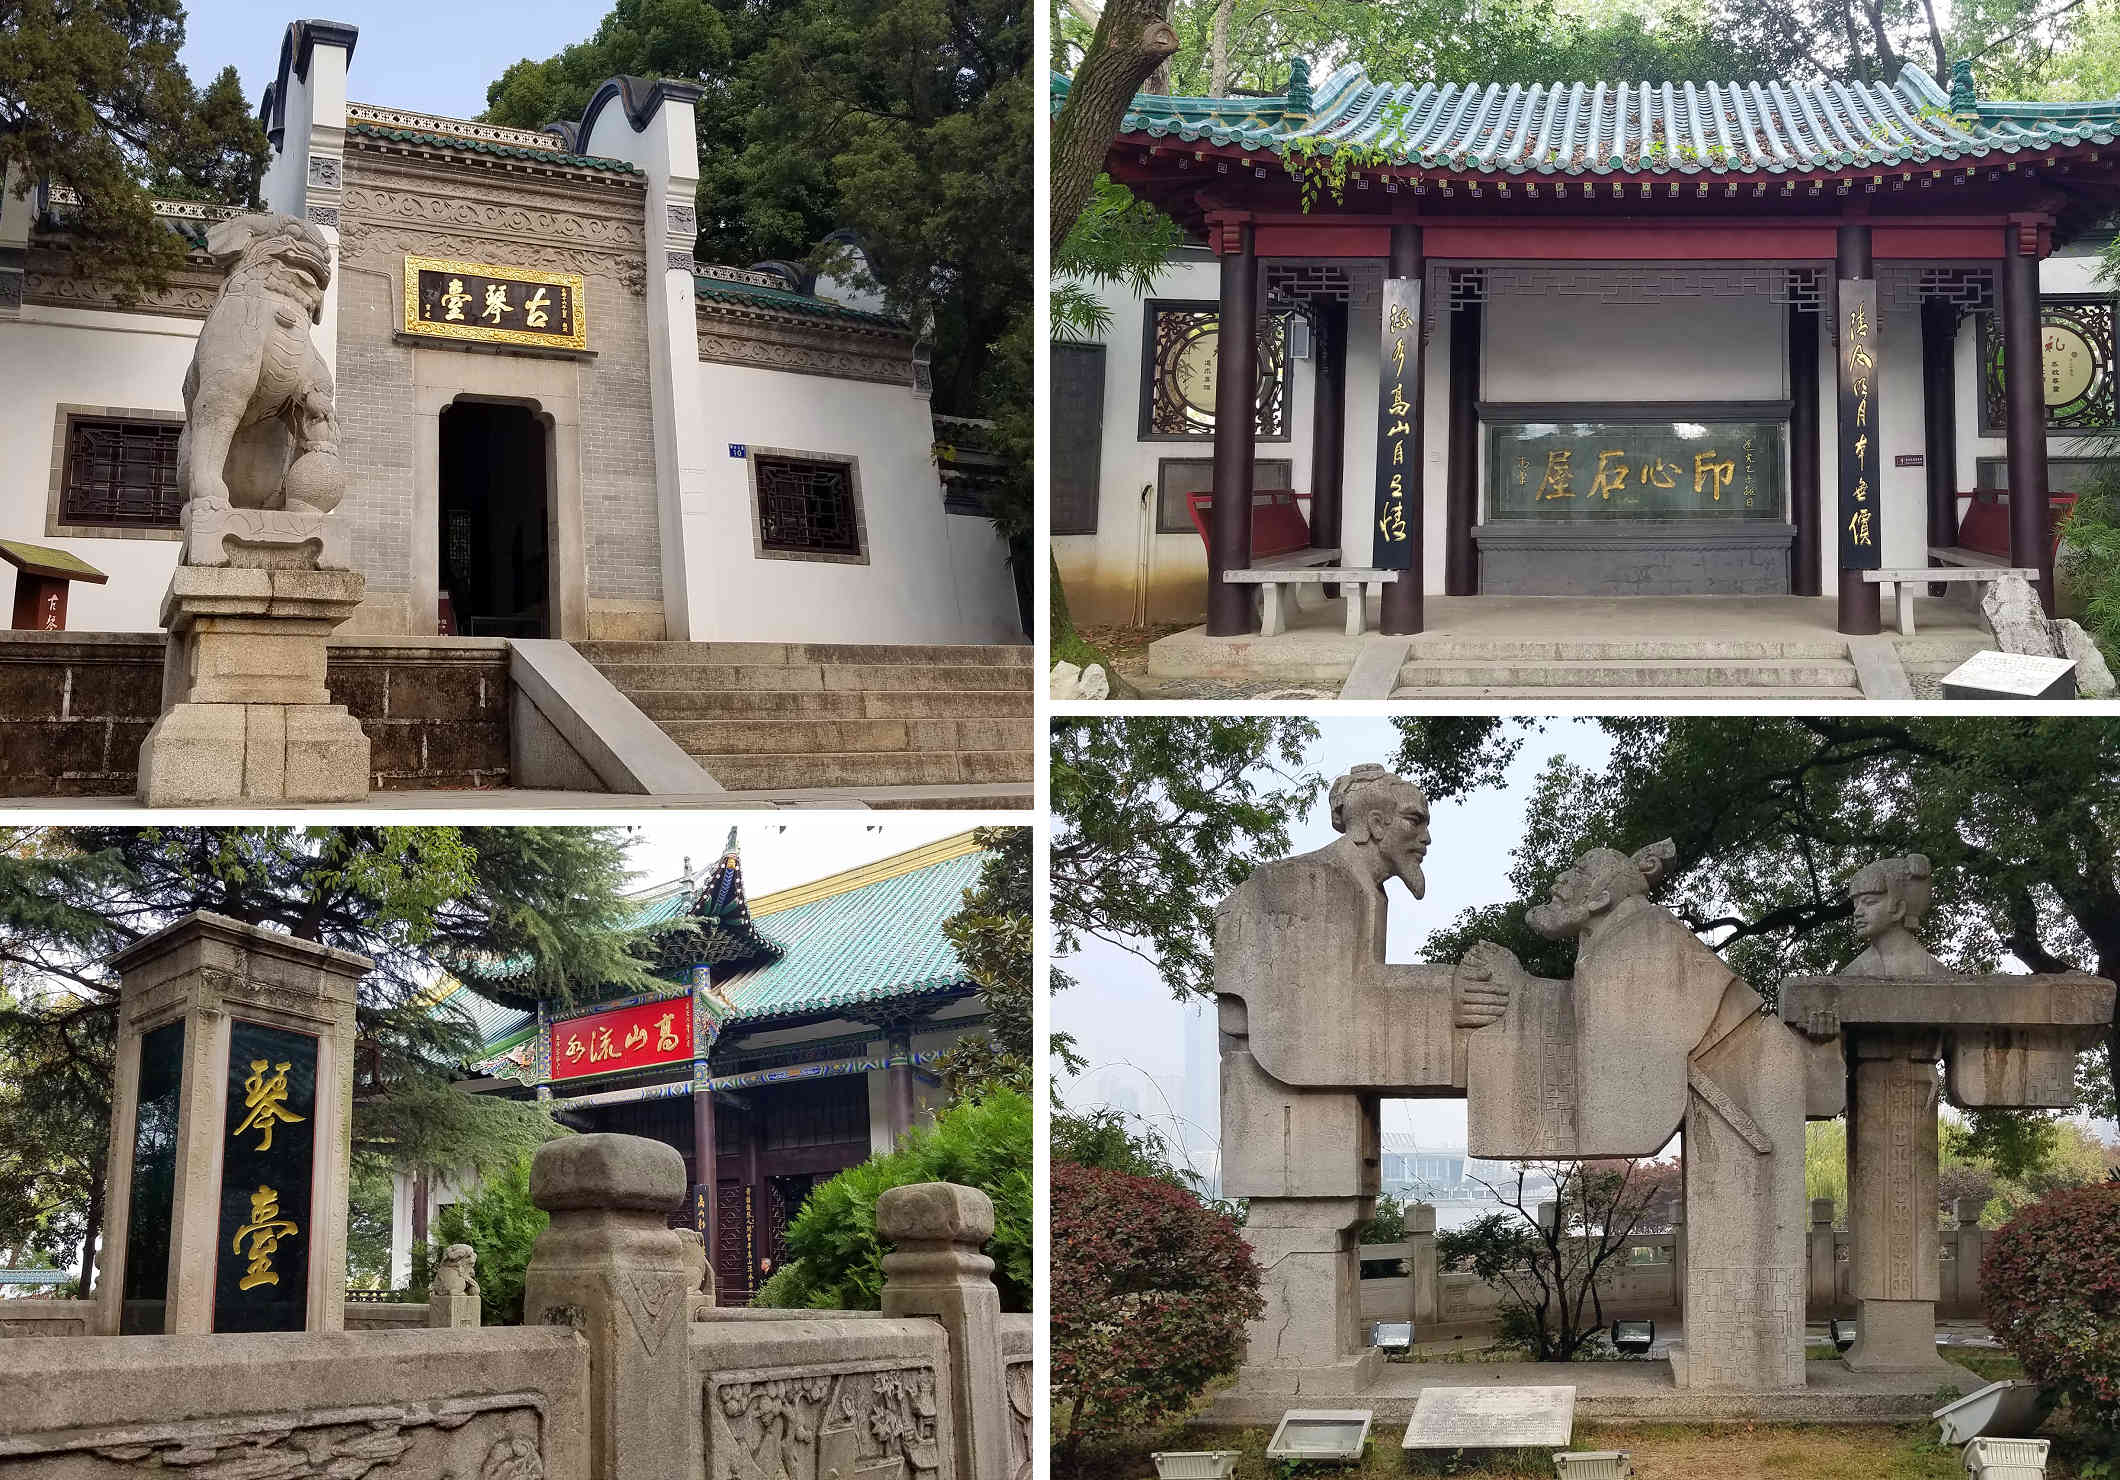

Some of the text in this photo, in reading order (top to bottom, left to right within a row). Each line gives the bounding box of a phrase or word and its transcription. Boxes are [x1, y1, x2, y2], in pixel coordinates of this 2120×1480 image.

[1535, 449, 1736, 501] 印心石屋
[565, 1013, 679, 1064] 高山流水
[232, 1059, 307, 1291] 琴臺
